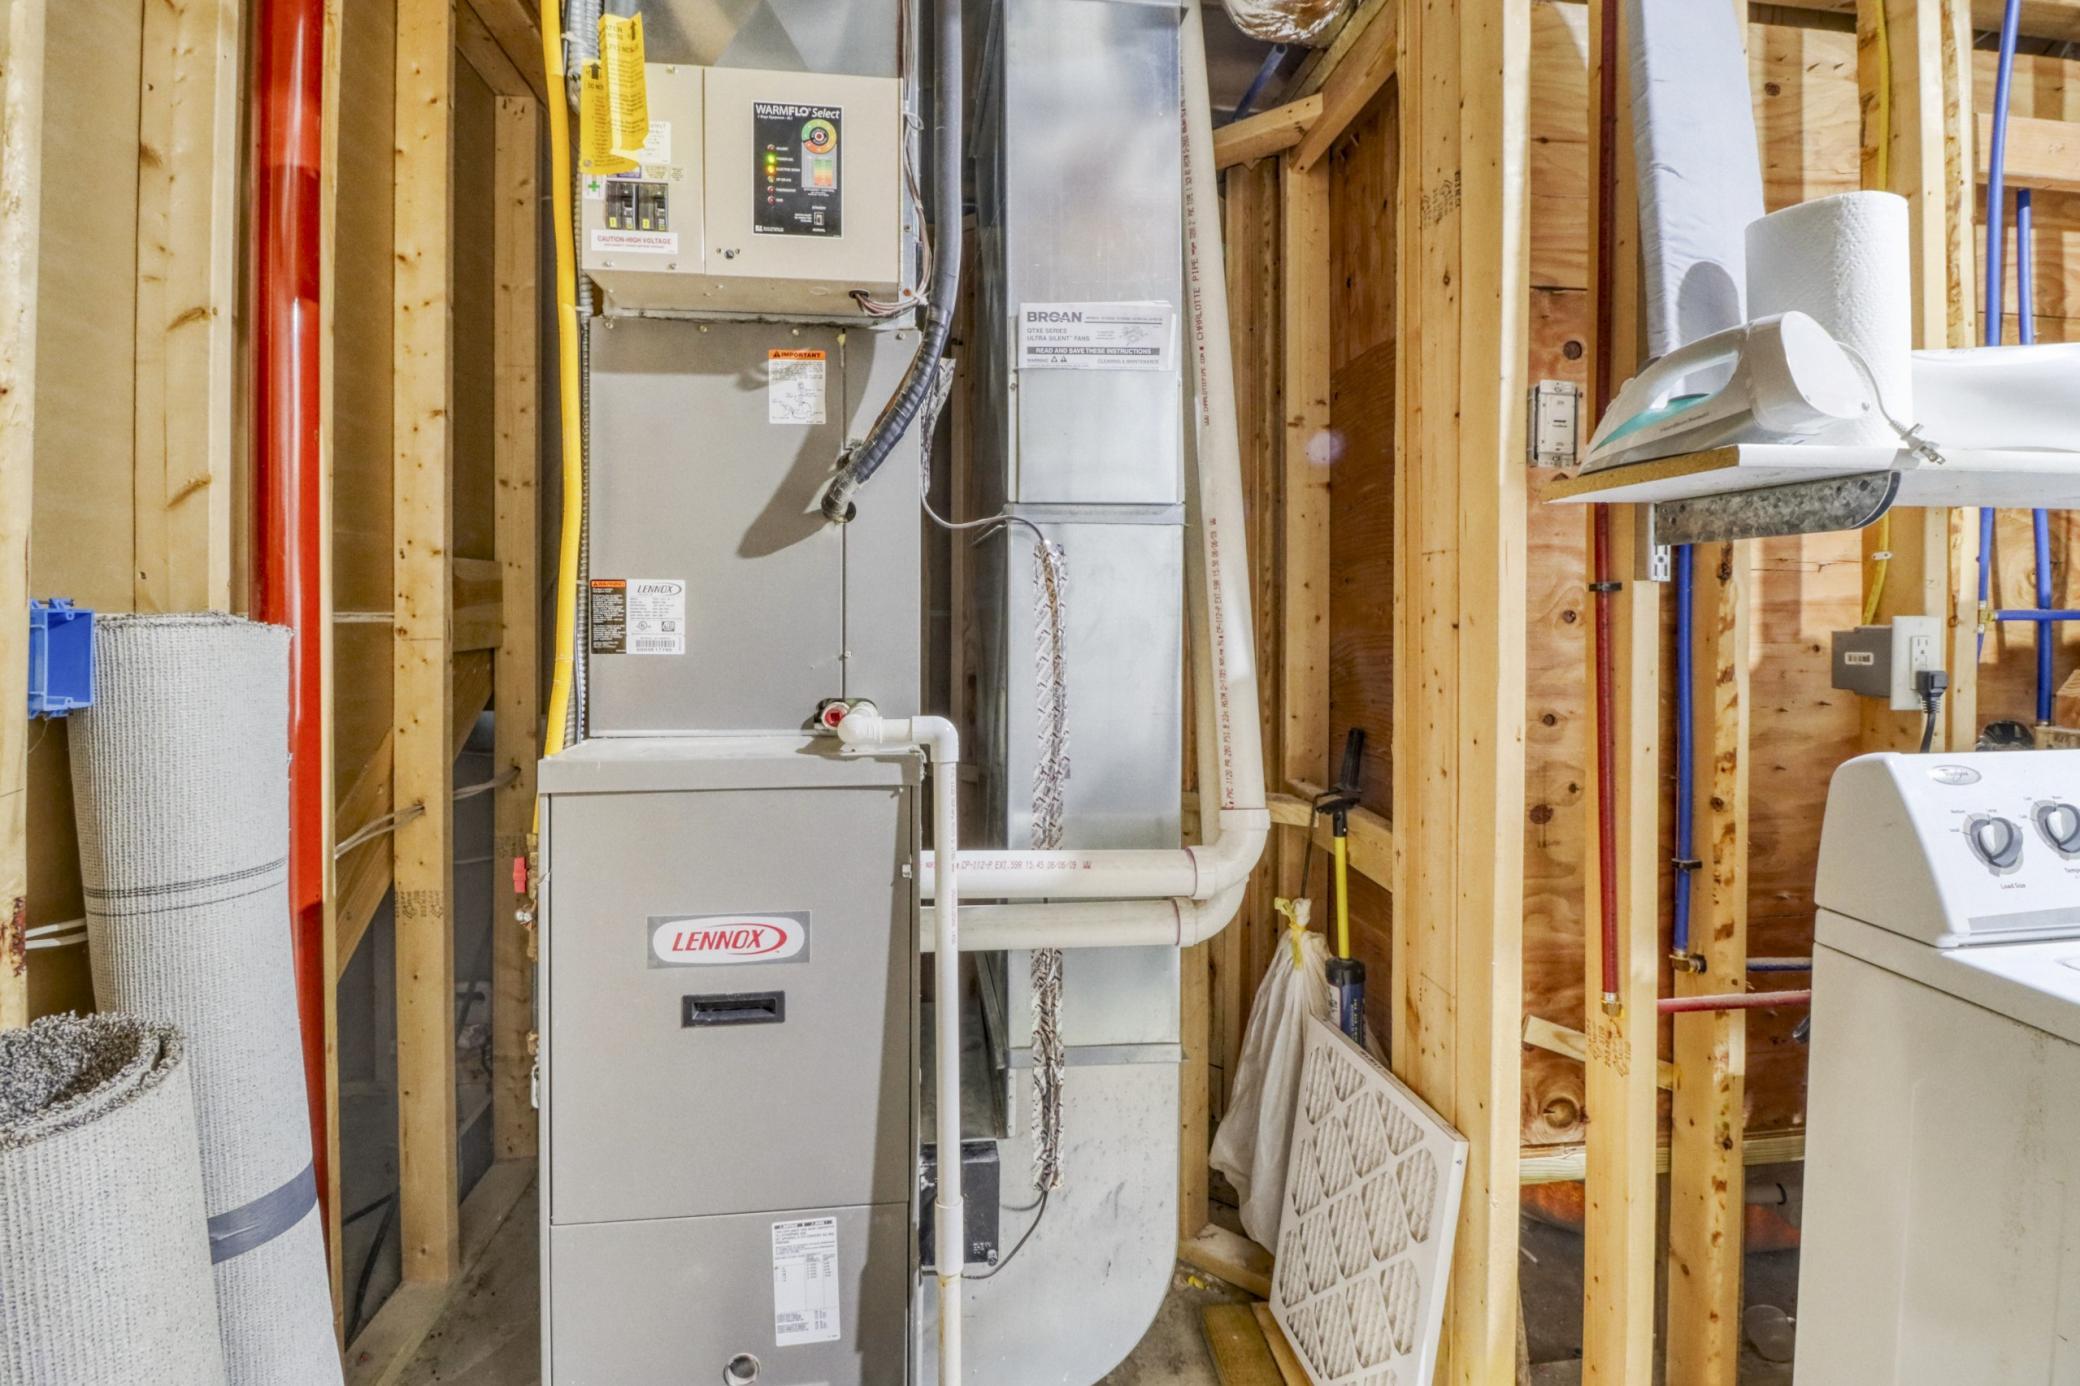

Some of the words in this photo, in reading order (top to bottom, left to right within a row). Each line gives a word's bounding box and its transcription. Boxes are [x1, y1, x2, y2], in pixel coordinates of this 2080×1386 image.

[755, 103, 809, 117] WARMFLO
[811, 107, 841, 119] Select
[643, 237, 672, 245] VOLTAGE
[1190, 257, 1200, 282] PIPE
[1026, 311, 1083, 323] BROAN
[1026, 334, 1047, 342] ULTRA
[637, 584, 673, 594] LENNOX
[672, 929, 765, 952] LENNOX
